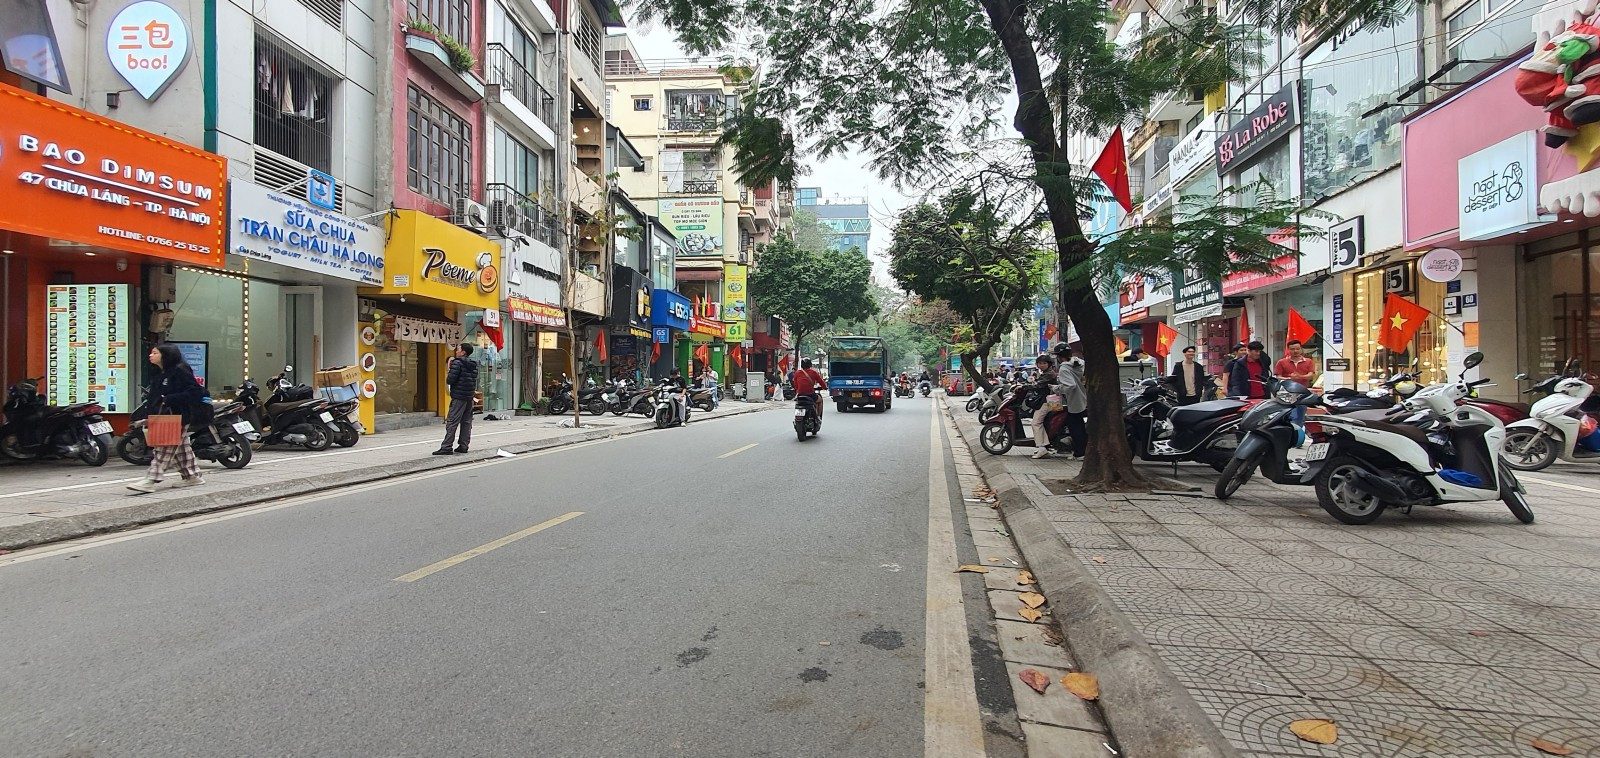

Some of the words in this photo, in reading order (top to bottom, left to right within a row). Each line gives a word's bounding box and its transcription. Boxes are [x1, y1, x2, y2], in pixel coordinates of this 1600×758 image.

[118, 19, 173, 50] 三包
[127, 53, 169, 70] bao!
[1234, 129, 1251, 150] La
[1252, 101, 1288, 138] Robe
[18, 134, 85, 165] BAO
[101, 158, 212, 201] DIMSUM
[18, 171, 45, 185] 47
[145, 202, 166, 214] TP.
[169, 205, 188, 221] HÀ
[189, 209, 211, 226] NỘI
[1464, 184, 1506, 213] dessert
[98, 225, 145, 242] HOTLINE:
[147, 235, 172, 248] 0766
[174, 240, 187, 250] 25
[188, 242, 198, 252] 15
[198, 243, 211, 255] 25
[239, 216, 284, 243] TRÂN
[288, 230, 329, 255] CHÂU
[352, 250, 385, 269] LONG
[320, 221, 356, 244] CHUA
[1339, 227, 1357, 266] 5
[267, 245, 302, 259] YOGURT
[310, 257, 328, 266] MILK
[329, 261, 342, 269] TEA
[349, 267, 373, 277] COFFEE
[422, 247, 476, 284] Poeme
[1390, 268, 1402, 289] 5
[1465, 294, 1474, 305] 60
[729, 325, 741, 336] 61
